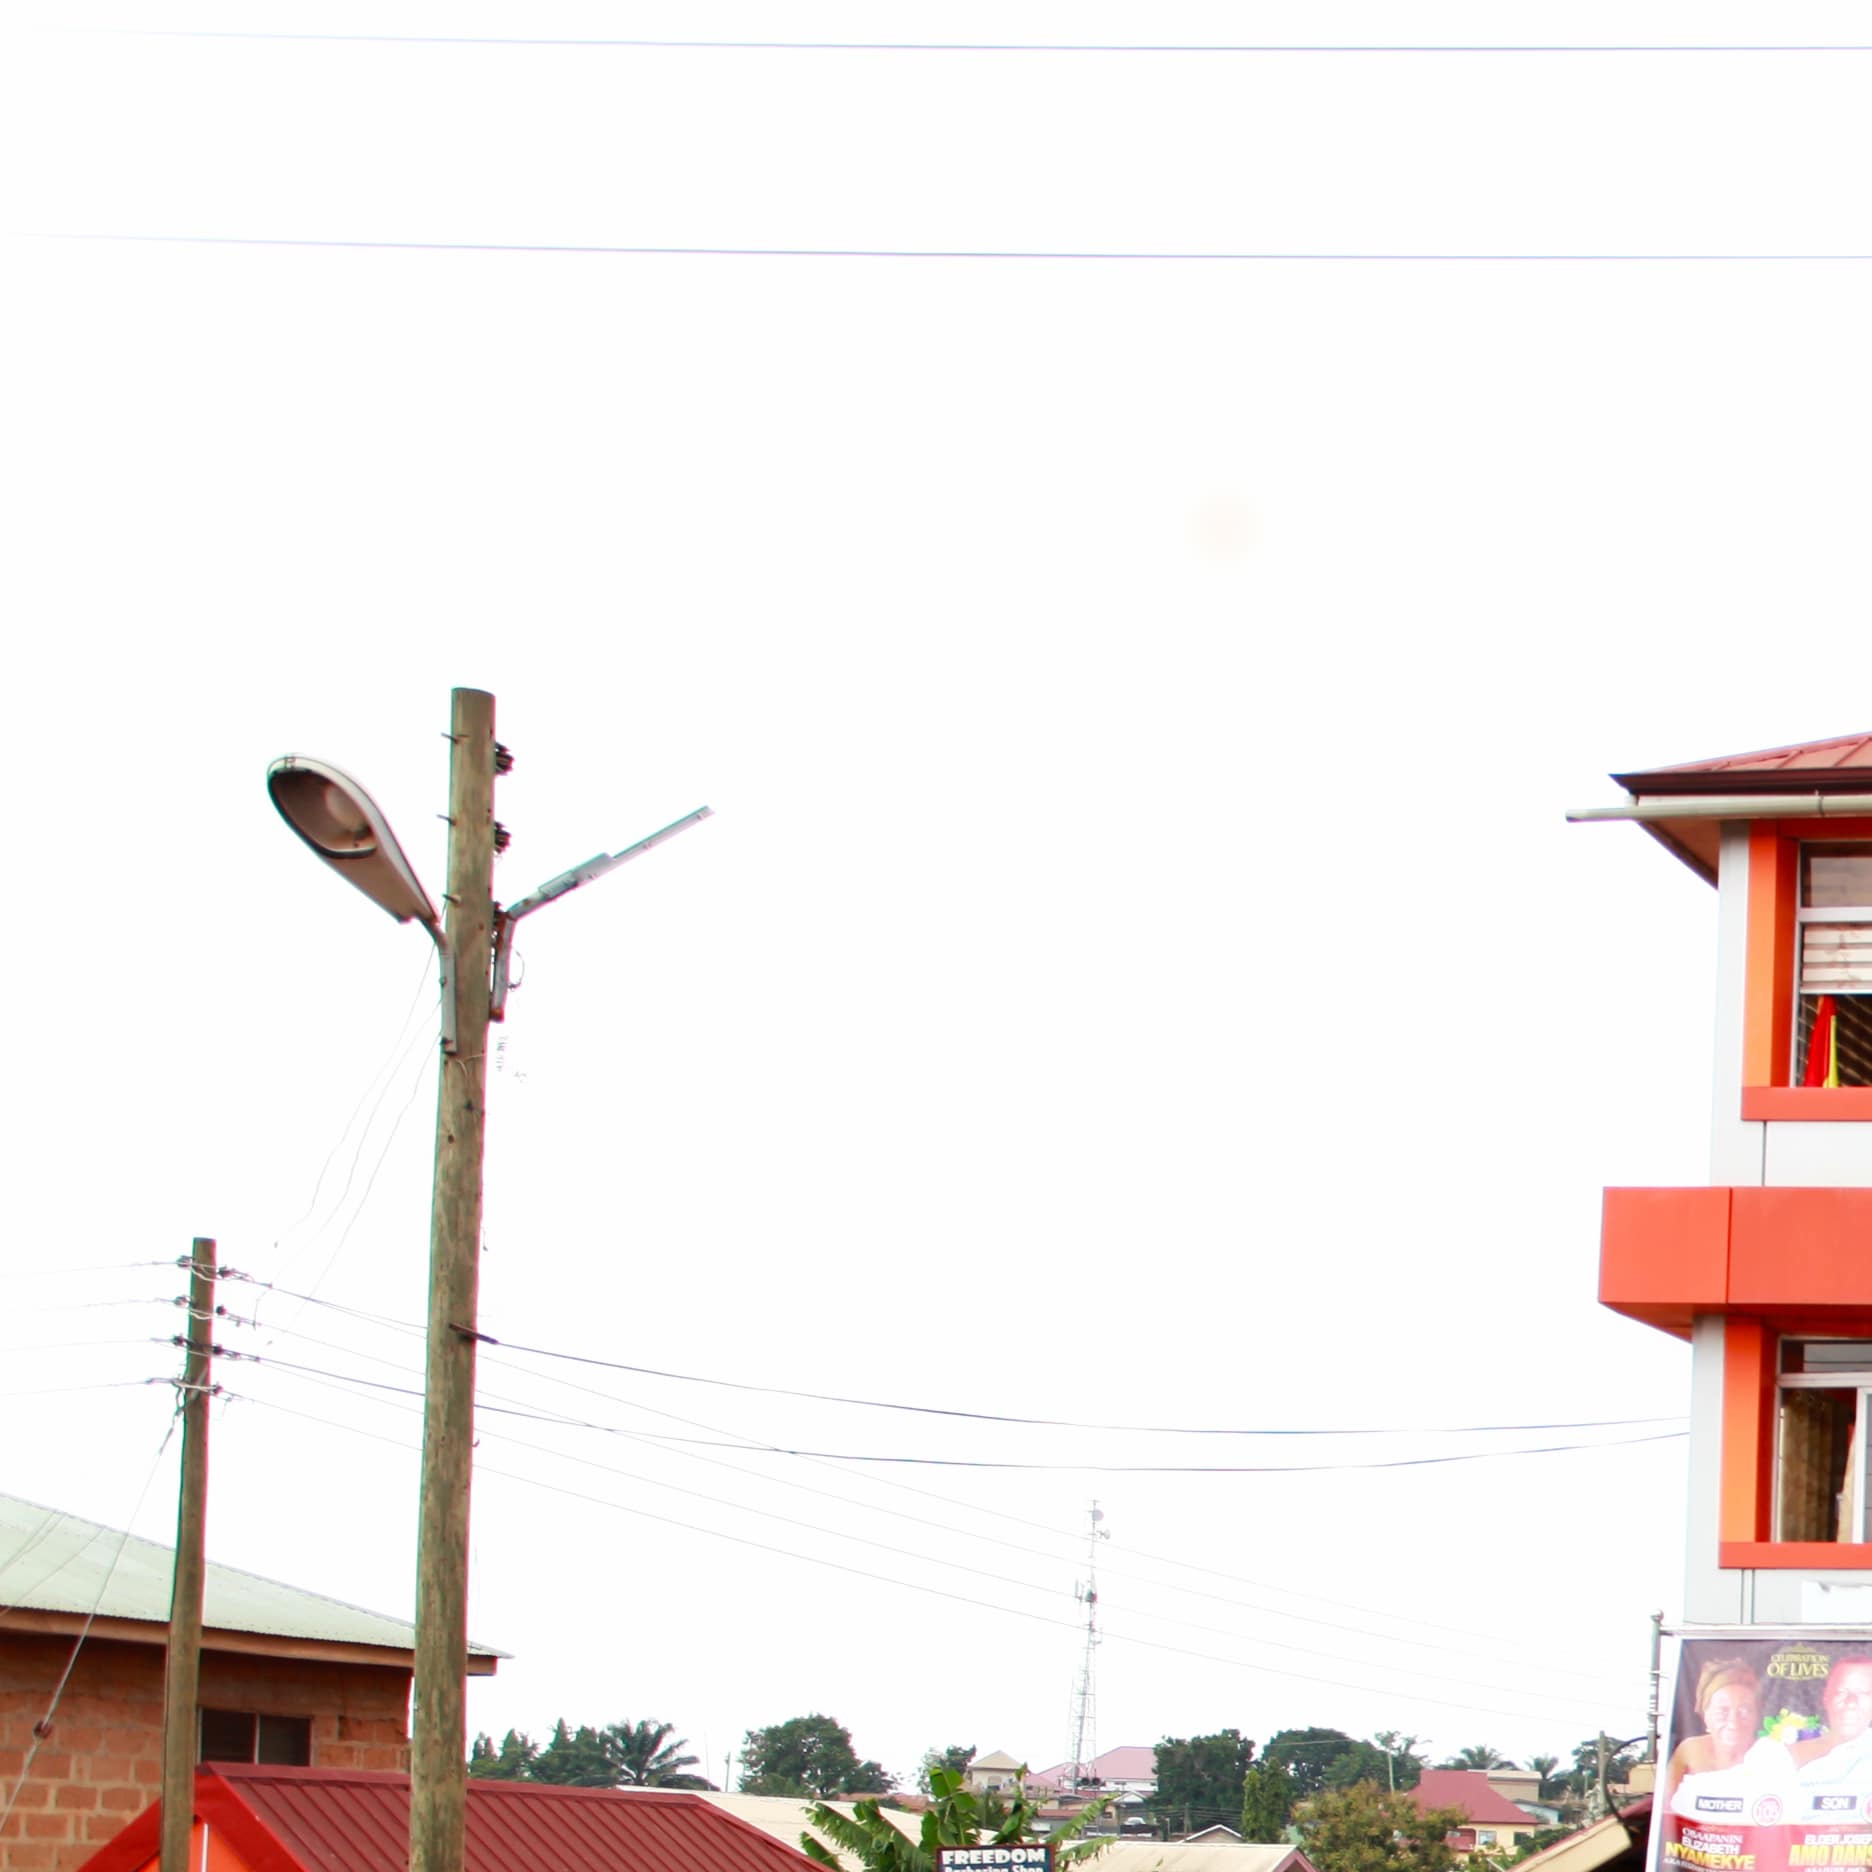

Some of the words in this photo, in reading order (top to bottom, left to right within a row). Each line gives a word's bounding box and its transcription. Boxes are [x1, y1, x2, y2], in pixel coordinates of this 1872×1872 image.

[1767, 1663, 1787, 1677] OF
[1790, 1663, 1829, 1677] LIVES
[1699, 1798, 1742, 1811] MOTHER
[1821, 1797, 1849, 1809] SON
[1682, 1836, 1741, 1855] ELIZABETH
[941, 1848, 1046, 1865] FREEDOM
[1665, 1841, 1756, 1870] NYAMEKYE
[1788, 1843, 1830, 1867] AMO
